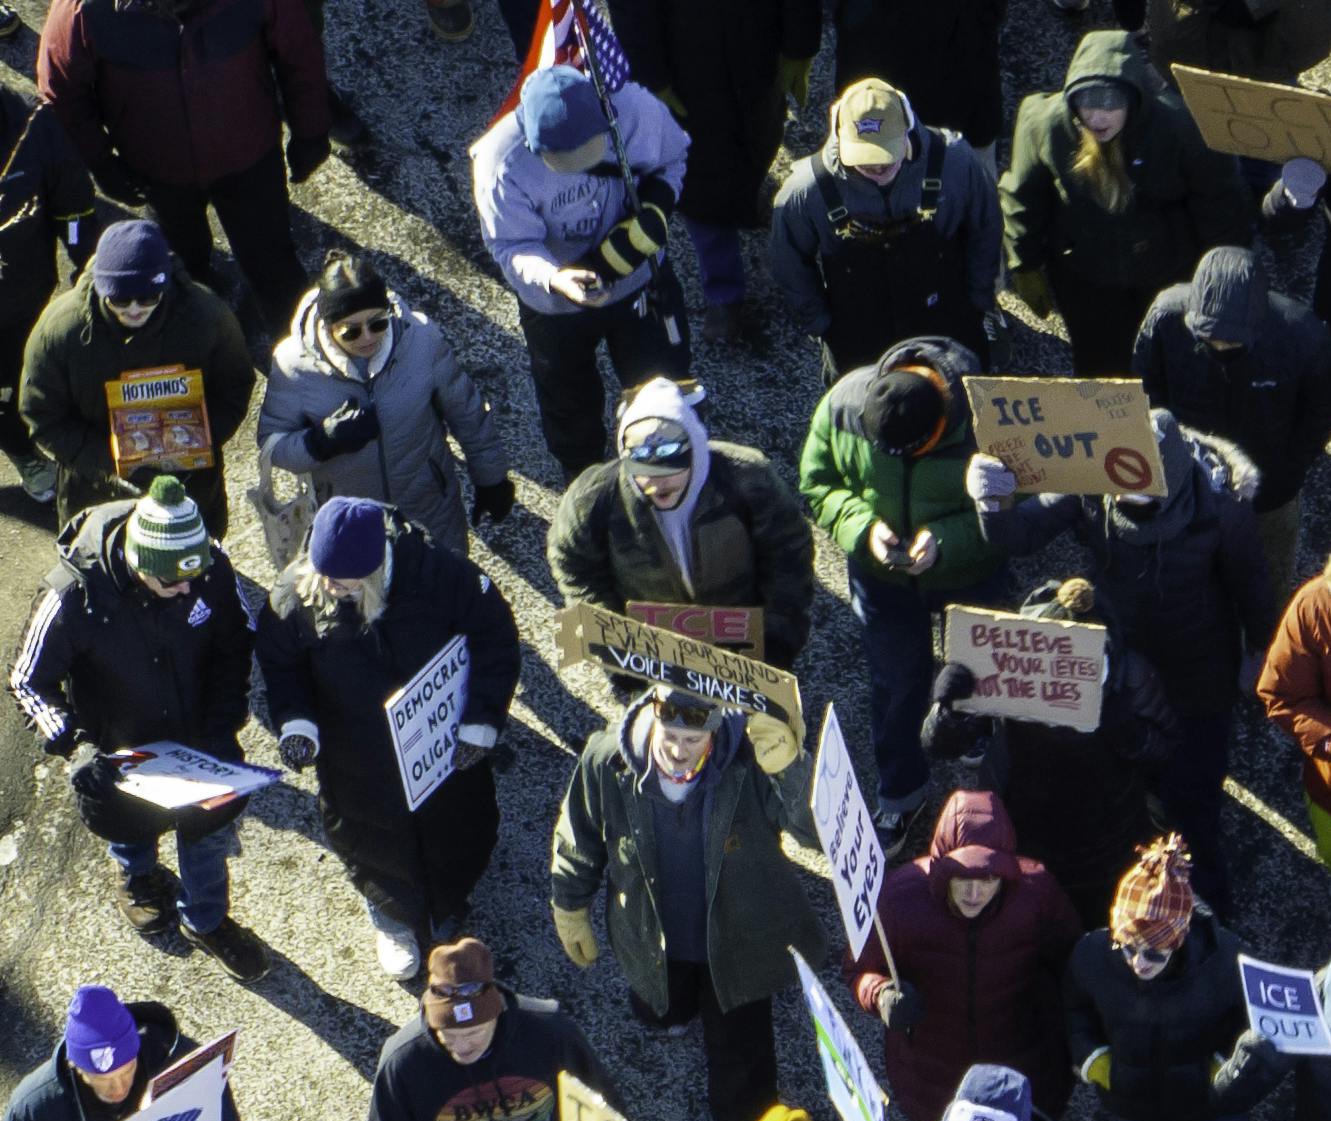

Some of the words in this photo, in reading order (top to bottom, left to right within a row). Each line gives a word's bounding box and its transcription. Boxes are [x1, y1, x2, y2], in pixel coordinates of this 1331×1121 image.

[991, 397, 1045, 427] ICE
[1034, 432, 1098, 459] OUT
[630, 606, 749, 640] ICE
[971, 624, 1074, 655] BELIEVE
[594, 613, 664, 648] SPEAK
[679, 639, 718, 672] YOUR
[722, 654, 779, 685] MIND
[599, 623, 661, 661] EVEN
[672, 648, 691, 667] IF
[713, 662, 758, 690] YOUR
[991, 653, 1046, 675] YOUR
[1055, 659, 1098, 677] EYES
[395, 646, 468, 731] DEMOCRAC
[608, 646, 673, 682] VOICE
[687, 672, 768, 713] SHAKES
[1002, 677, 1037, 699] THE
[1041, 681, 1082, 702] LIES
[427, 692, 455, 733] NOT
[829, 771, 853, 867] Believe
[841, 808, 865, 890] Your
[853, 842, 879, 932] Eyes
[1259, 979, 1302, 1011] ICE
[1258, 1014, 1317, 1040] OUT
